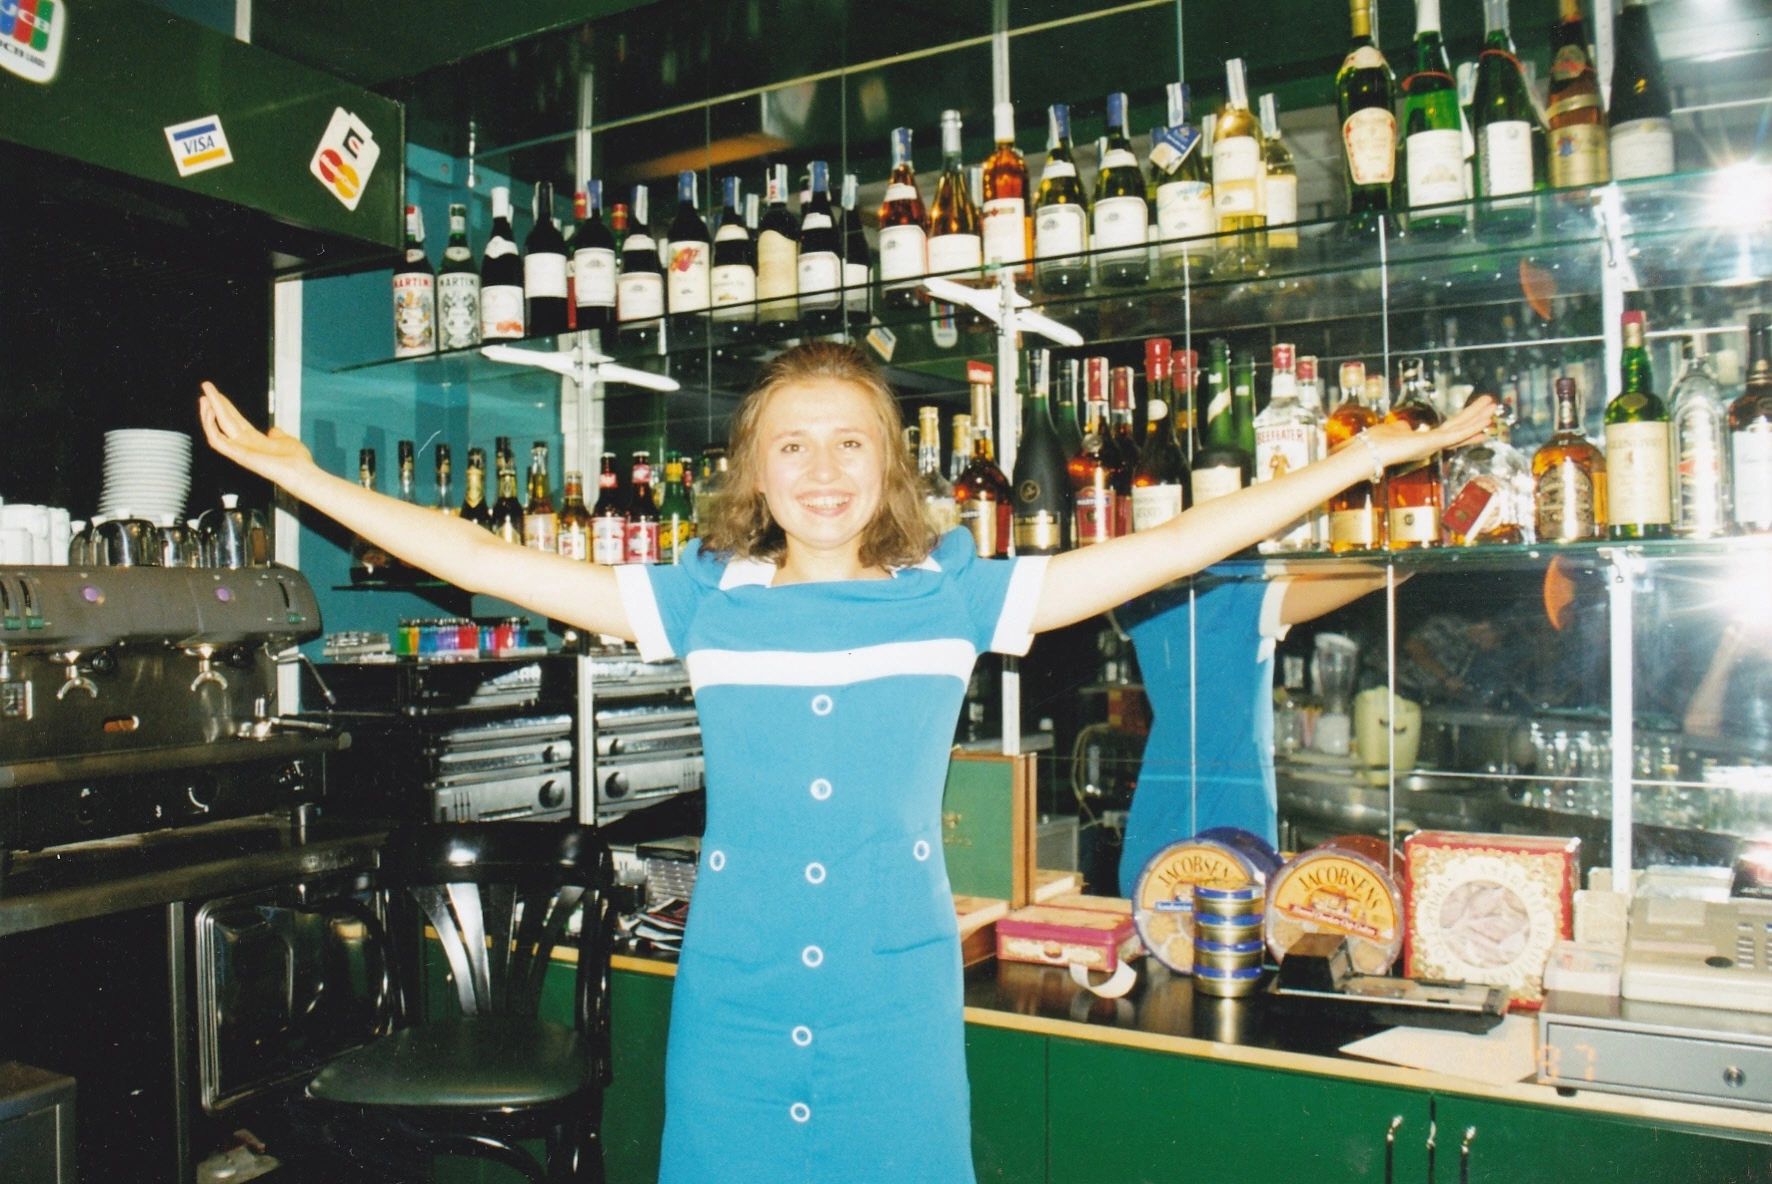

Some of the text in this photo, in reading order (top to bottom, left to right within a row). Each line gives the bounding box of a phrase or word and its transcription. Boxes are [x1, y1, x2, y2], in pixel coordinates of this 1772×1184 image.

[184, 135, 215, 155] VISA
[393, 277, 429, 288] MARTIN
[439, 277, 475, 287] MARTIN
[1257, 429, 1304, 445] BEEFEATER
